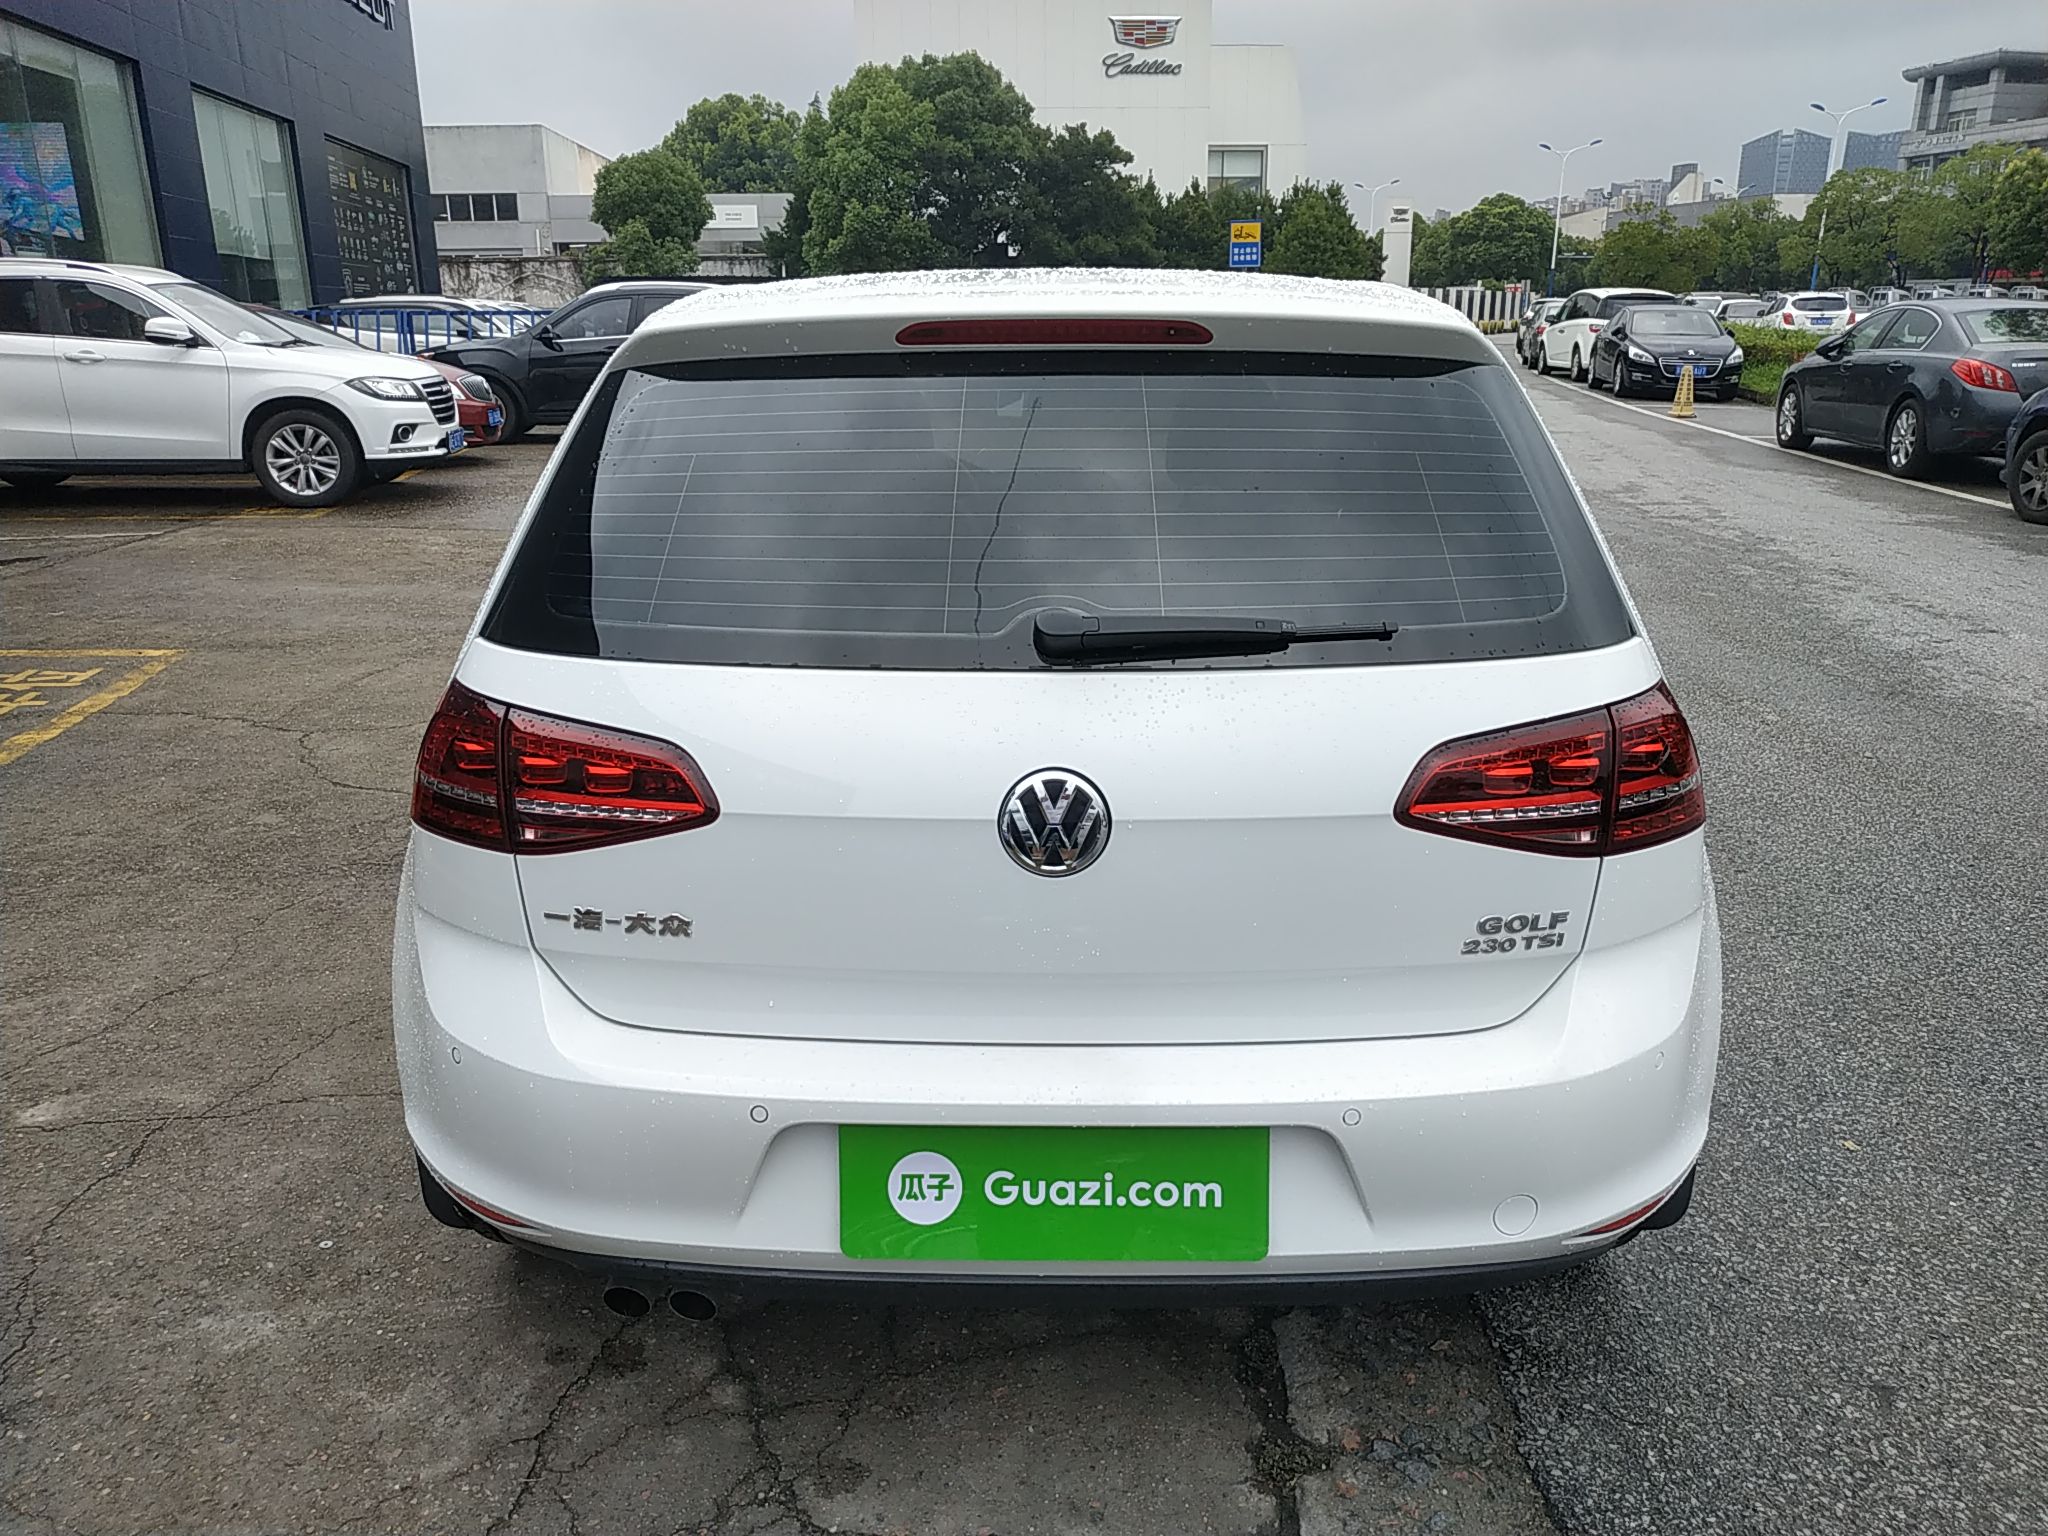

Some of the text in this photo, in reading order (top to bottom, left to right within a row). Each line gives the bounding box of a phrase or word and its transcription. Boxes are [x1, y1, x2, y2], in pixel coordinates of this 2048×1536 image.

[1102, 52, 1182, 78] Cadillac
[1476, 910, 1570, 935] GOLF
[898, 1173, 955, 1201] 瓜子
[984, 1170, 1223, 1208] Guazi.com
